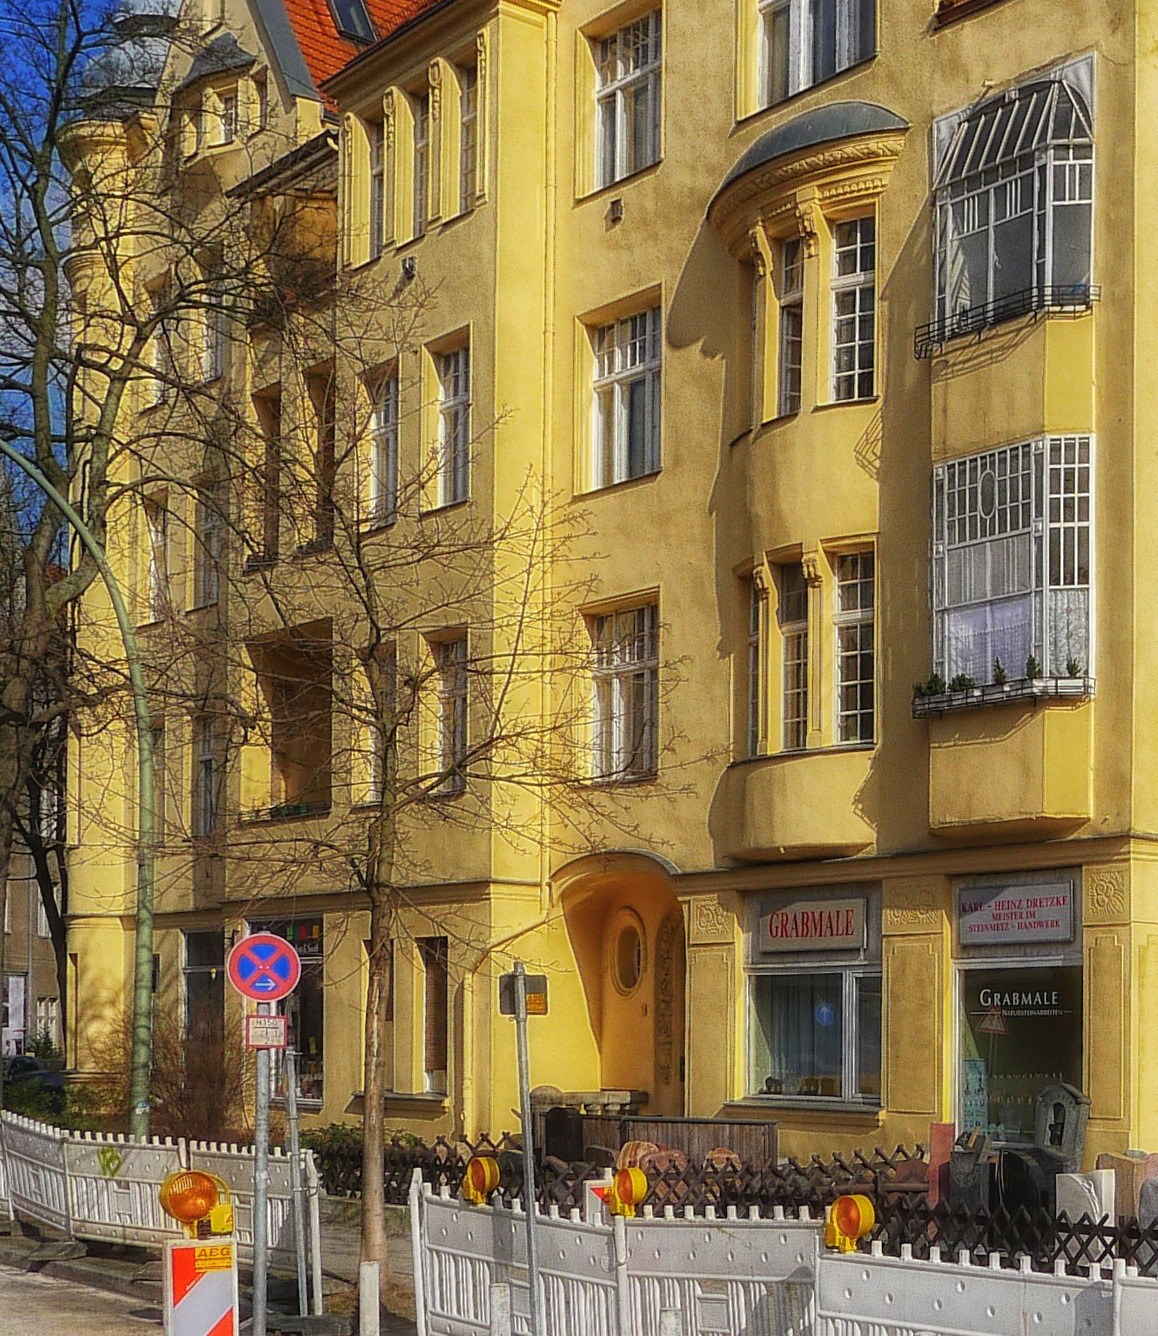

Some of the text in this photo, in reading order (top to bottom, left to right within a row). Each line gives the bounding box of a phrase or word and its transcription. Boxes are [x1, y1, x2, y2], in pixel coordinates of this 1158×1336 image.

[962, 902, 984, 913] KARL
[994, 899, 1023, 911] HEINZ
[1026, 895, 1068, 909] DRETZKE
[992, 910, 1036, 921] MEISTER IM
[769, 909, 854, 939] GRABMALE
[968, 922, 1010, 933] STEINMETZ
[1017, 920, 1060, 930] HANDWERK
